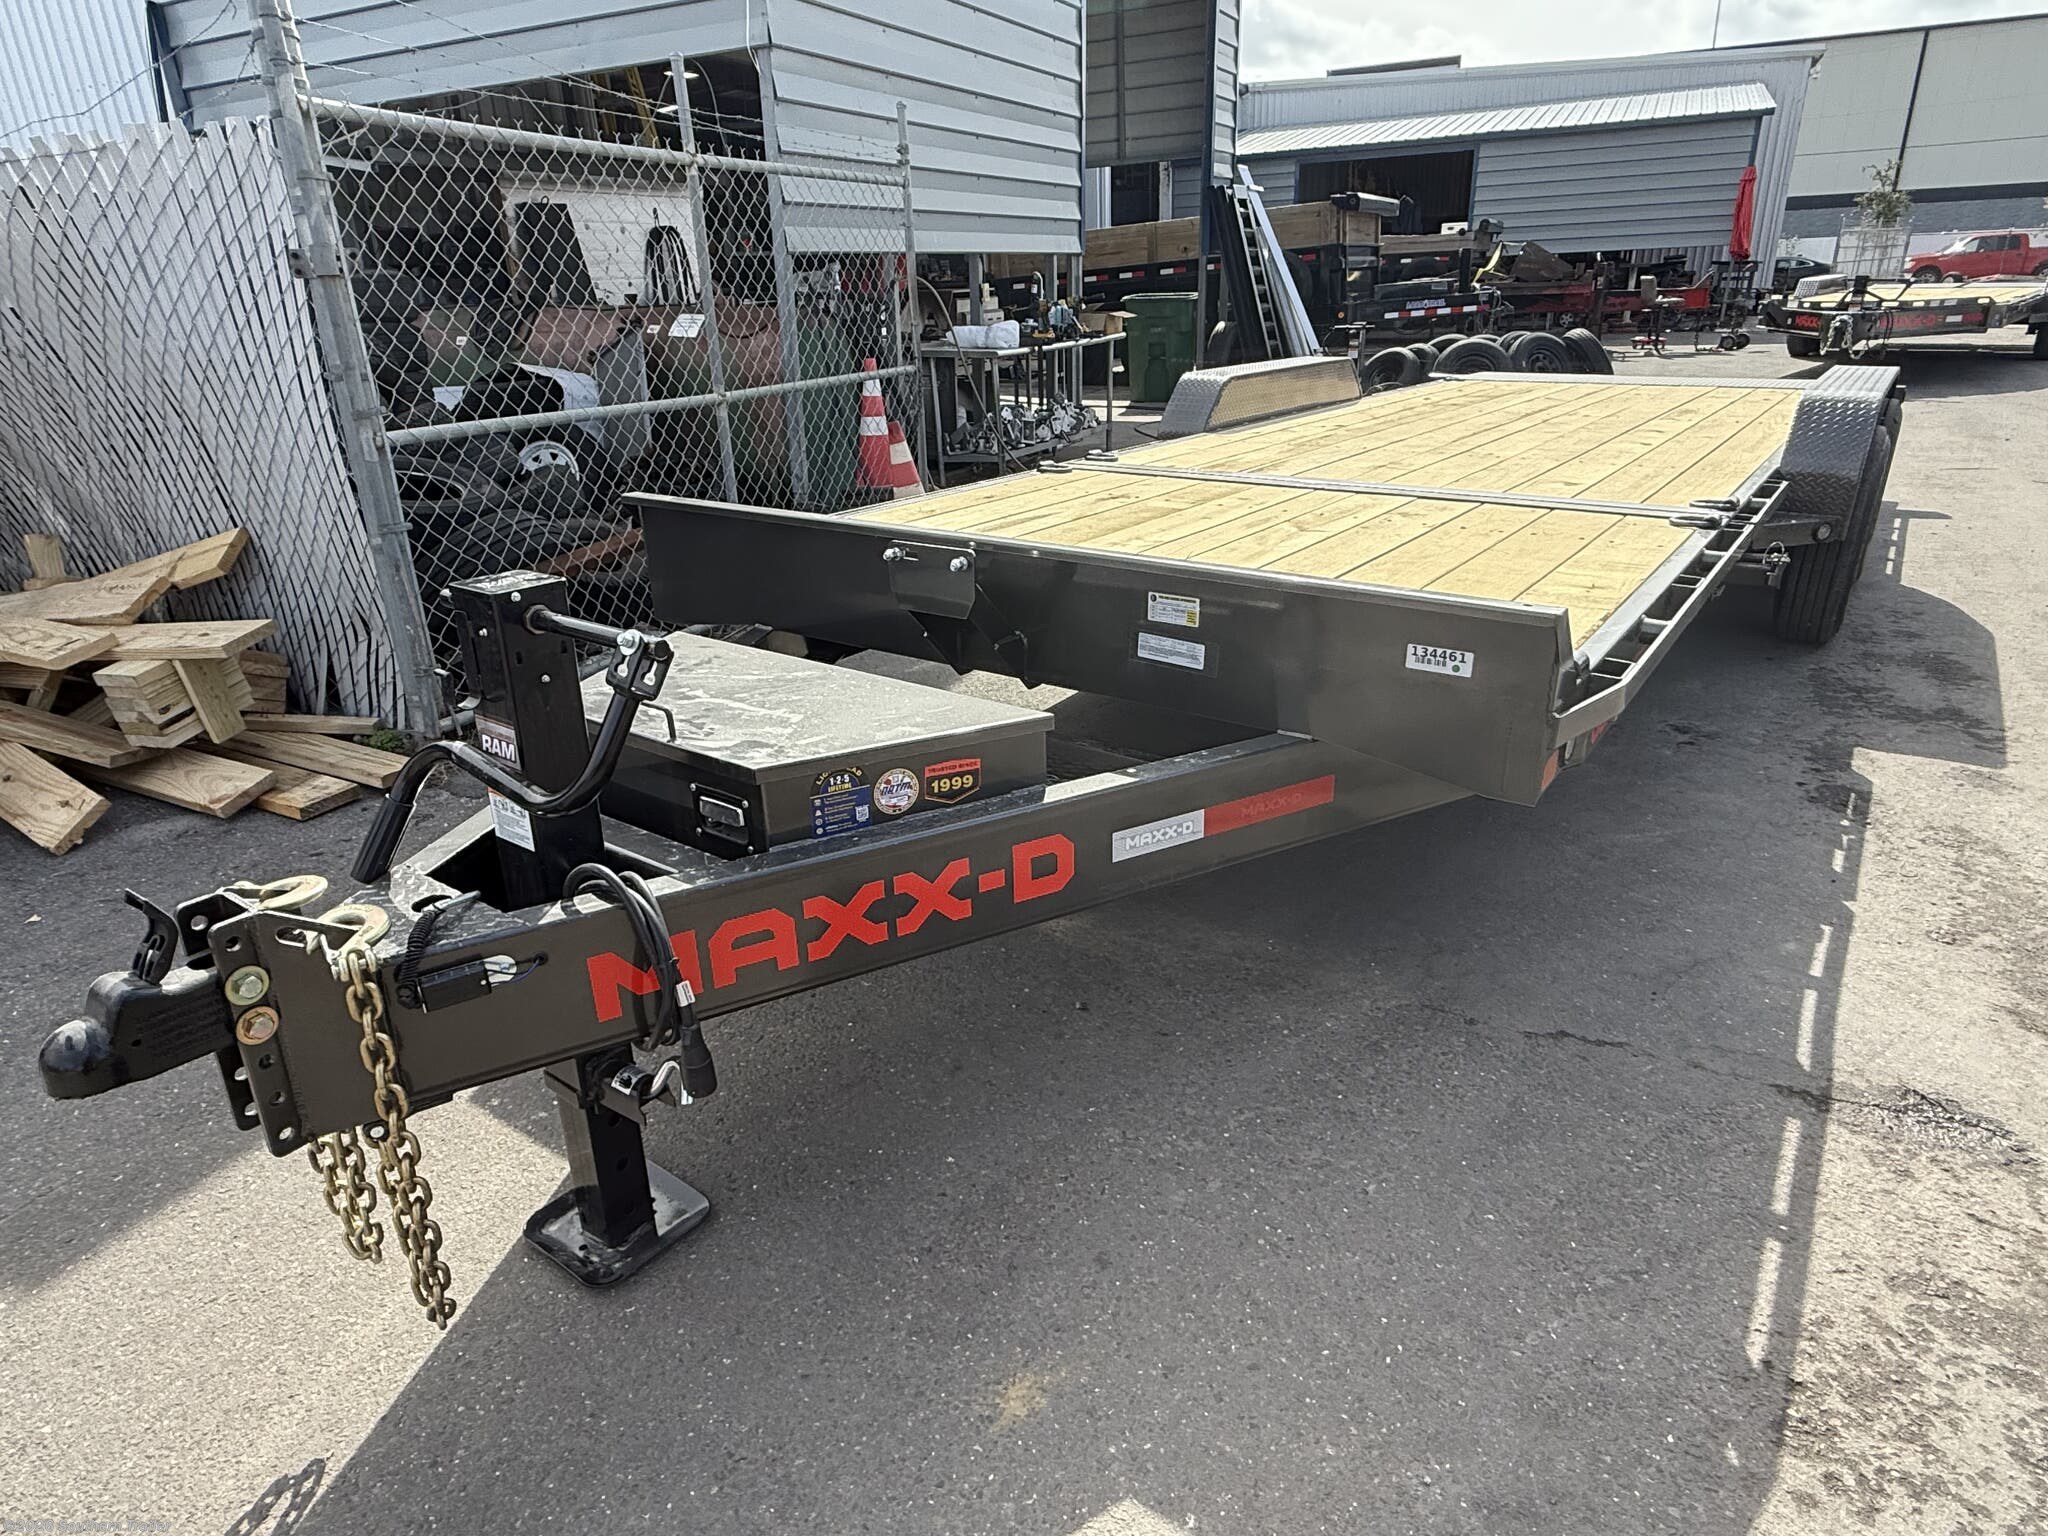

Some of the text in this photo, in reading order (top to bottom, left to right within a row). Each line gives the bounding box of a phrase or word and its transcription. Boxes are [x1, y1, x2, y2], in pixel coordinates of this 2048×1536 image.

[1411, 645, 1467, 664] 134461
[482, 734, 515, 761] RAM
[931, 774, 974, 793] 1999
[1240, 793, 1302, 816] MAXX-D
[1125, 821, 1194, 851] MAXX-D
[587, 833, 1075, 1023] MAXX-D
